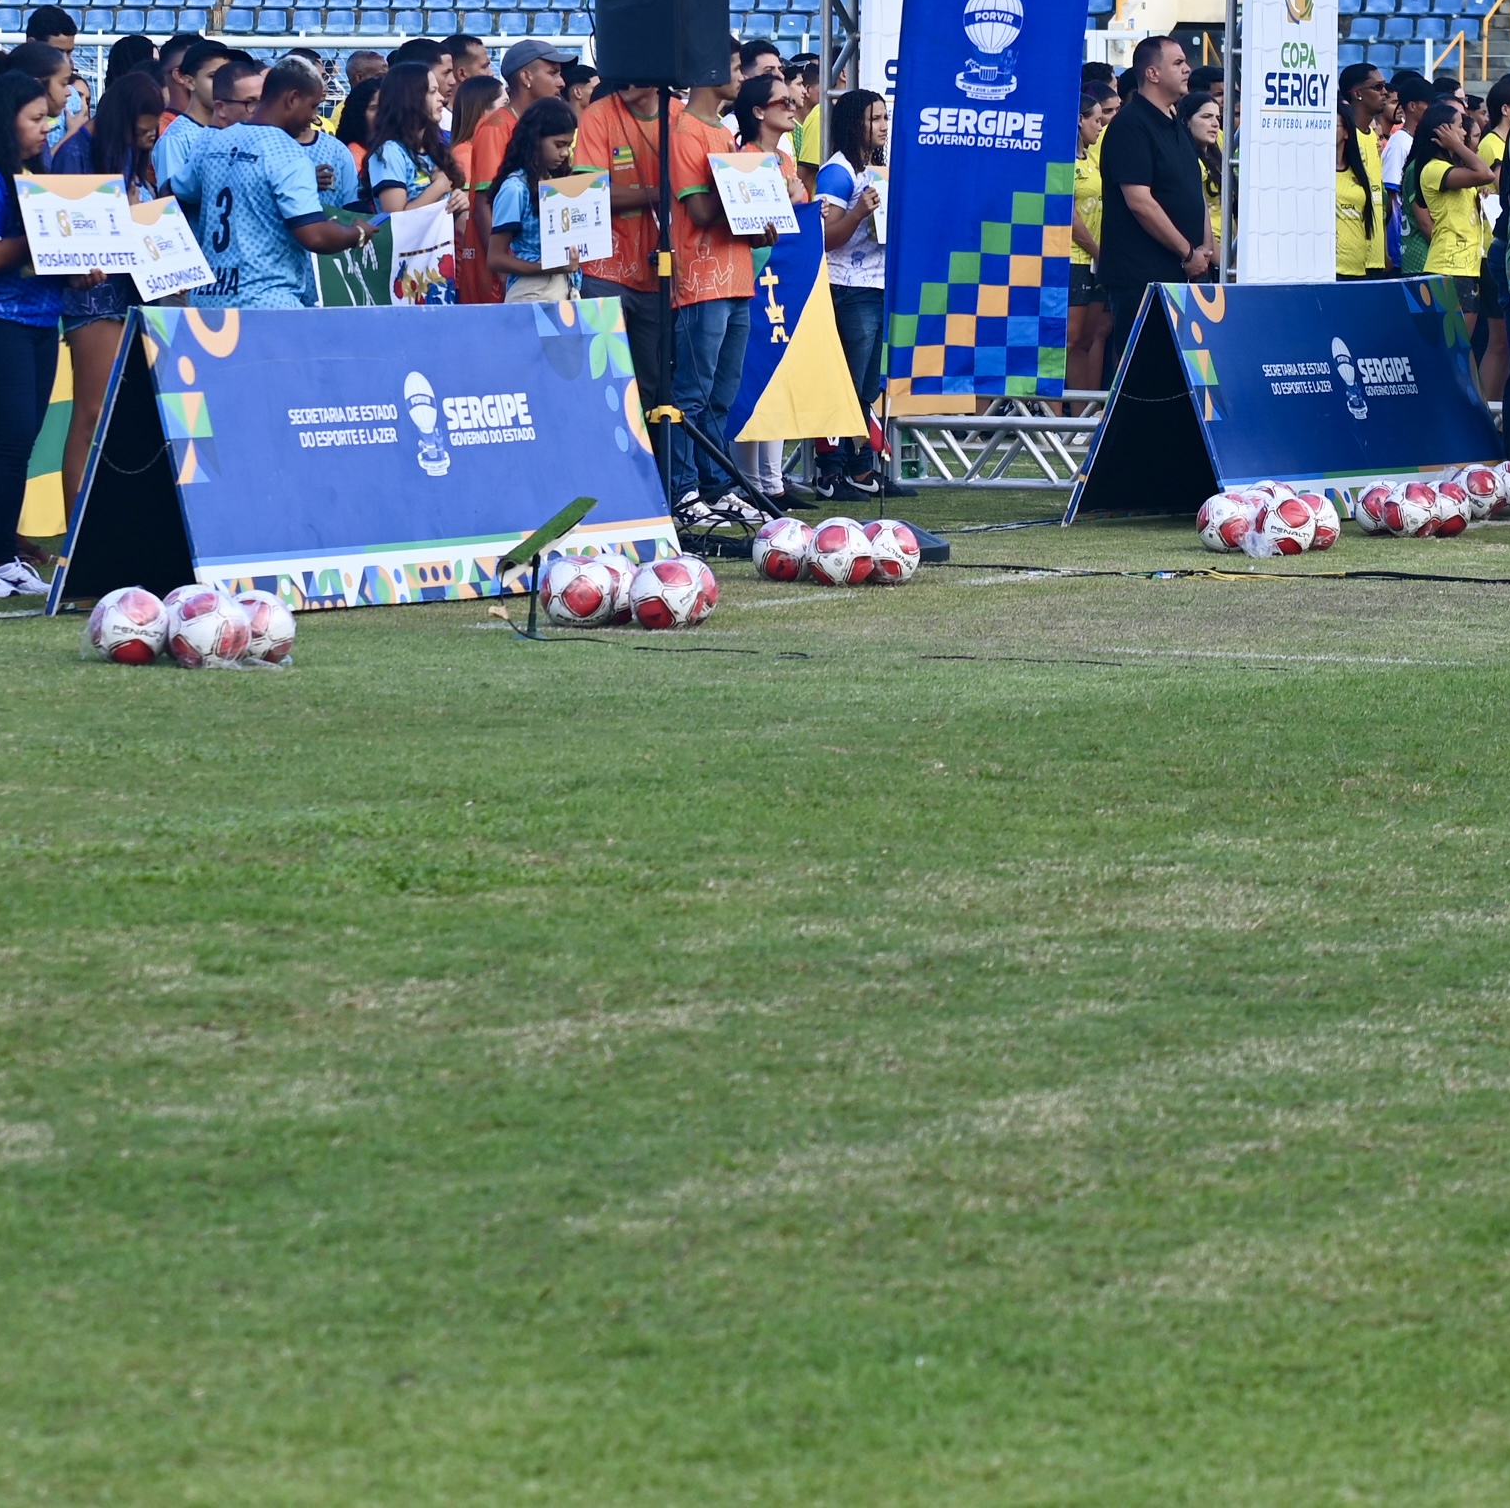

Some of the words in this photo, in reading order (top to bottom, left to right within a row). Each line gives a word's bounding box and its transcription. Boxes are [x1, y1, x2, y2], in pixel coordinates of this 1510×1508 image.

[974, 12, 1015, 24] PORVIR
[1281, 42, 1317, 69] COPA
[1264, 72, 1330, 107] SERIGY
[919, 107, 1044, 139] SERGIPE
[1262, 118, 1270, 128] DE
[1274, 119, 1302, 129] FUTEBOL
[918, 133, 976, 147] GOVERNO
[977, 136, 993, 147] DO
[995, 138, 1041, 151] ESTADO
[212, 187, 233, 253] 3
[732, 217, 760, 231] TOBIAS
[38, 250, 81, 268] ROSÁRIO
[82, 253, 97, 267] DO
[98, 252, 138, 267] CATETE
[564, 243, 589, 261] THA
[146, 274, 165, 294] SÃO
[163, 265, 207, 289] DOMINGOS
[1262, 364, 1297, 377] SECRETARIA
[1297, 363, 1305, 376] DE
[1305, 362, 1331, 375] ESTADO
[1357, 357, 1415, 384] SERGIPE
[1271, 382, 1281, 395] DO
[1281, 381, 1309, 394] ESPORTE
[1313, 380, 1333, 393] LAZER
[1398, 384, 1419, 396] ESTADO
[288, 406, 347, 425] SECRETARIA
[346, 406, 360, 423] DE
[360, 404, 398, 422] ESTADO
[442, 393, 533, 430] SERGIPE
[299, 431, 316, 448] DO
[315, 429, 359, 447] ESPORTE
[359, 429, 367, 444] E
[366, 427, 398, 444] LAZER
[449, 429, 489, 447] GOVERNO
[489, 428, 503, 444] DO
[502, 427, 536, 442] ESTADO
[1270, 525, 1312, 538] PENALTY
[112, 624, 166, 640] PENALTY
